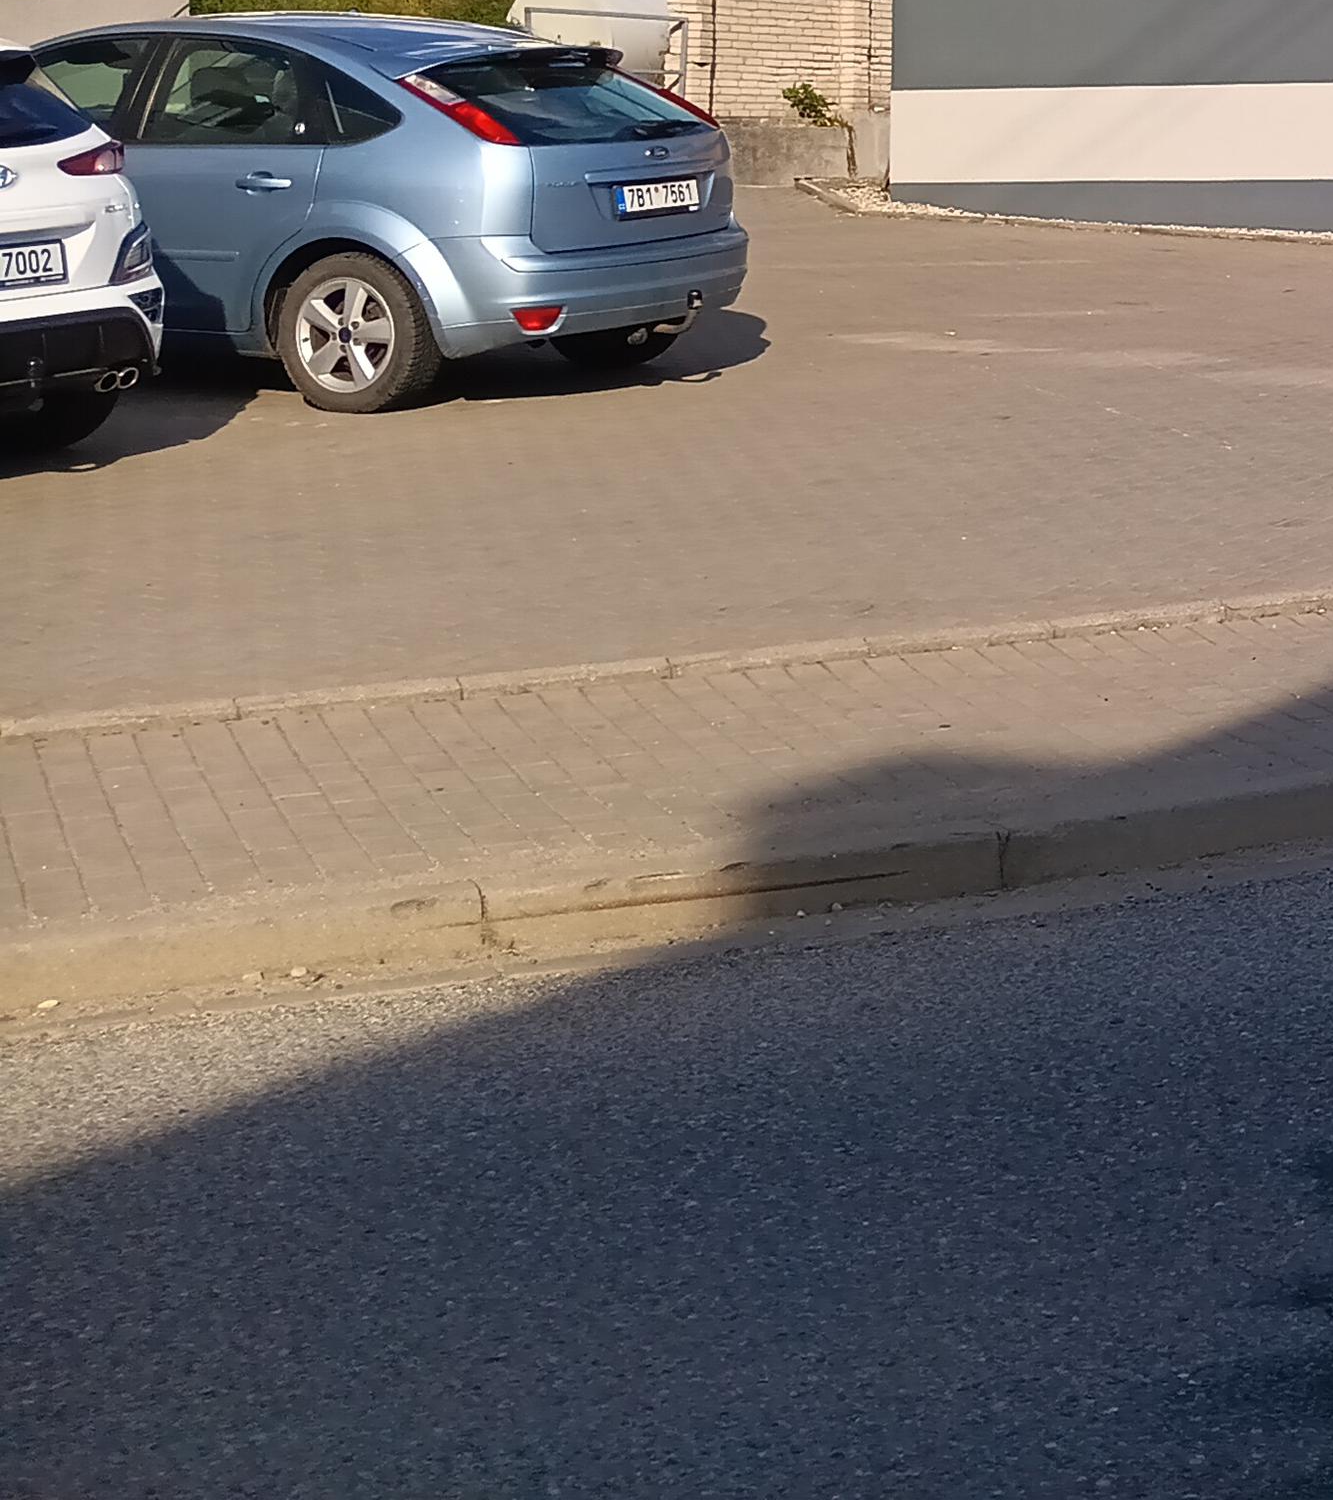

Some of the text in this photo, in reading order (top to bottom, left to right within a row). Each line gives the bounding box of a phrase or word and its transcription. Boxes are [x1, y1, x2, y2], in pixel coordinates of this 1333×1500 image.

[628, 183, 693, 210] 7B1 7561
[2, 248, 53, 278] 7002
